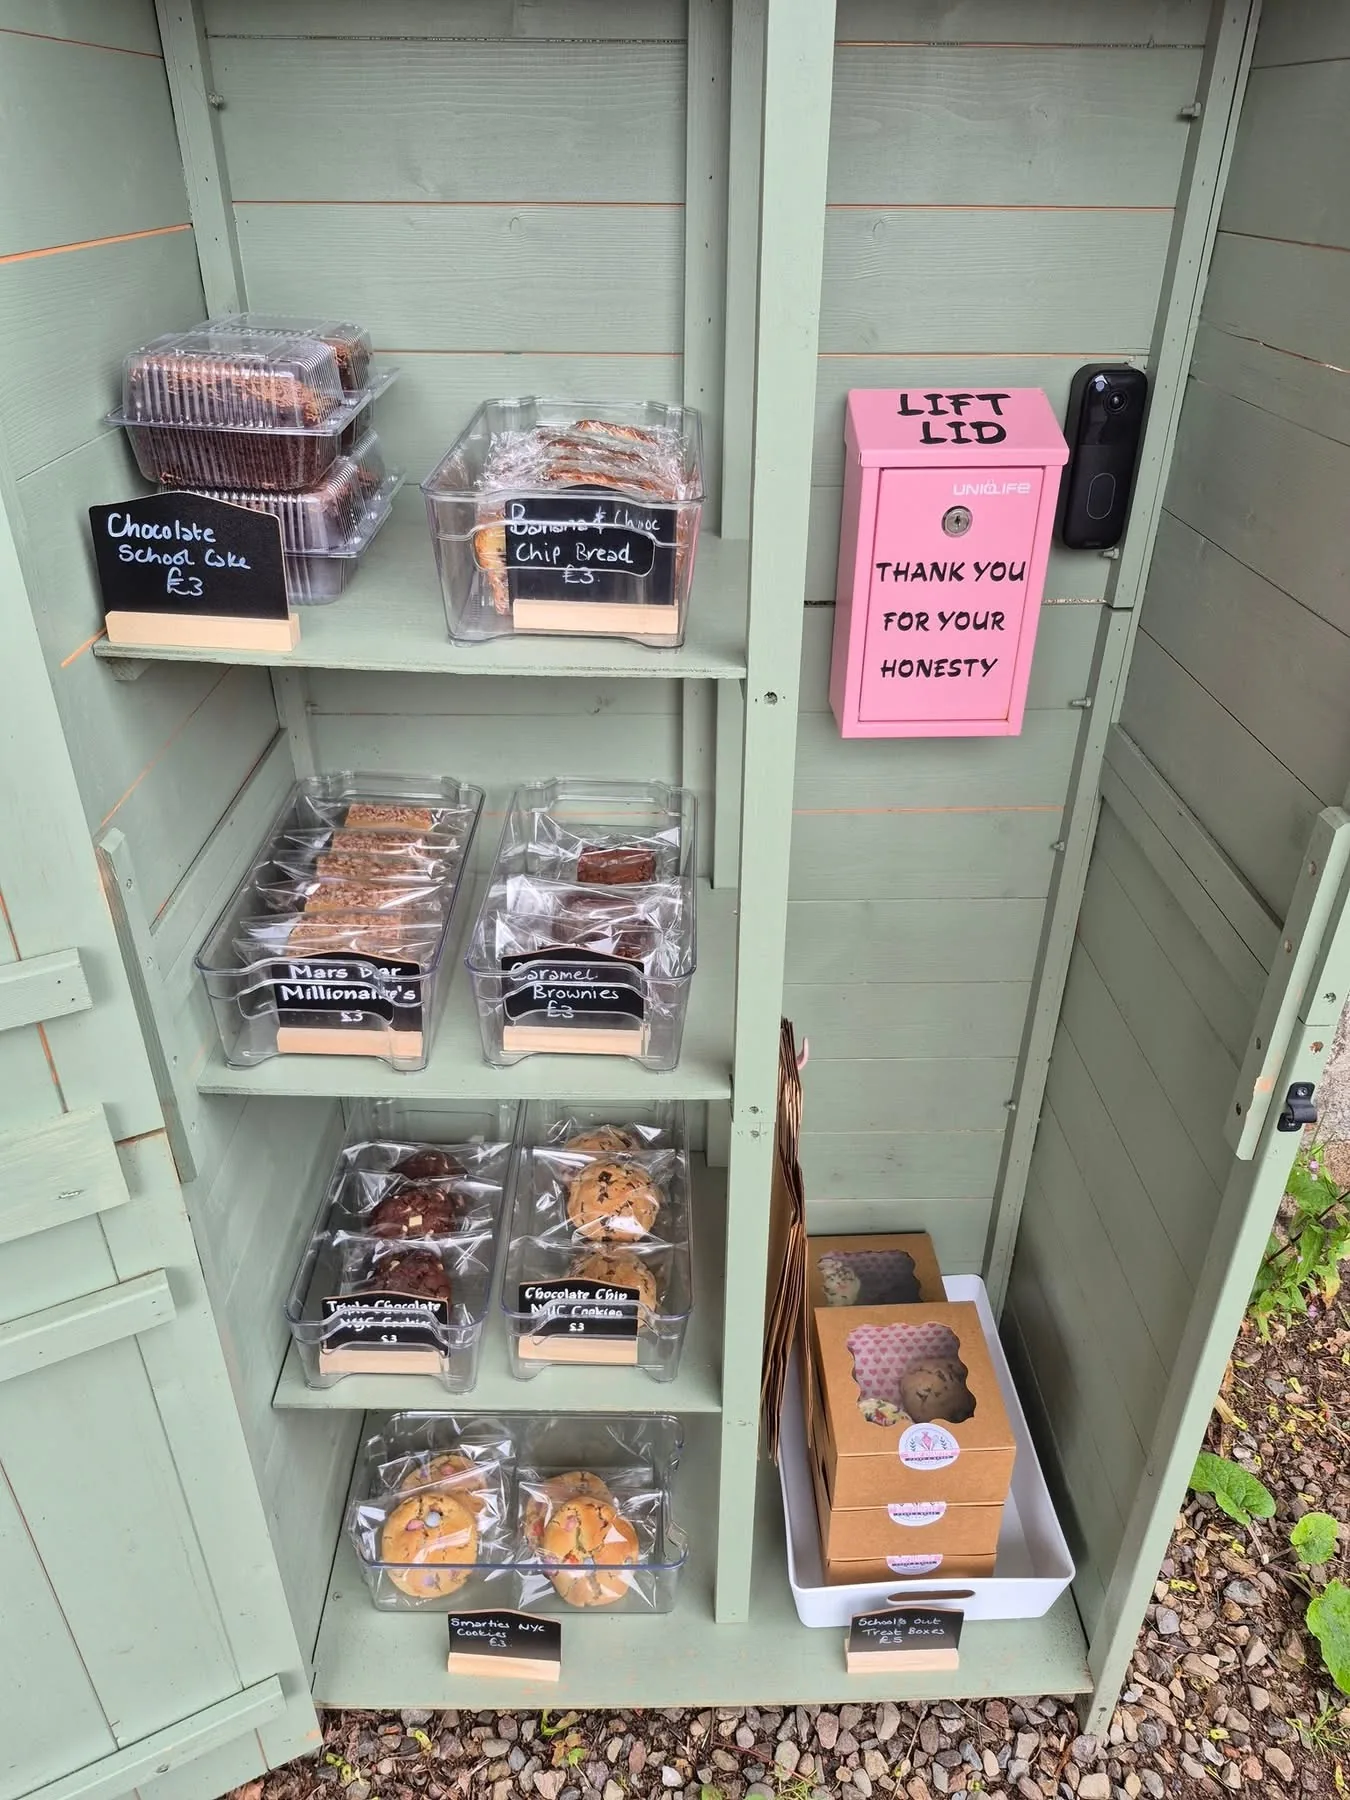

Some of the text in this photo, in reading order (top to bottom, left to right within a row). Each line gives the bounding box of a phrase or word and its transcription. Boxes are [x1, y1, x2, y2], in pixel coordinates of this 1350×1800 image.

[897, 393, 1011, 416] LIFT
[919, 421, 1007, 444] LID
[107, 513, 216, 543] Chocolate
[509, 503, 588, 535] Banana
[592, 506, 607, 535] &
[119, 544, 251, 570] School Cake
[515, 542, 634, 564] Chip Bread
[876, 560, 1026, 582] THANK YOU
[166, 566, 204, 596] £3
[883, 611, 1006, 632] FOR YOUR
[880, 658, 998, 678] HONESTY
[288, 964, 349, 980] Mars
[533, 985, 620, 1000] Brownies
[340, 1010, 364, 1023] £3
[547, 1000, 575, 1019] £3
[525, 1286, 628, 1302] Chocolate Chip
[373, 1299, 442, 1315] Chocolate
[569, 1322, 585, 1332] £3
[450, 1617, 545, 1632] Smarties NYC
[457, 1628, 507, 1639] Cookies
[861, 1628, 945, 1637] Treat Boxes
